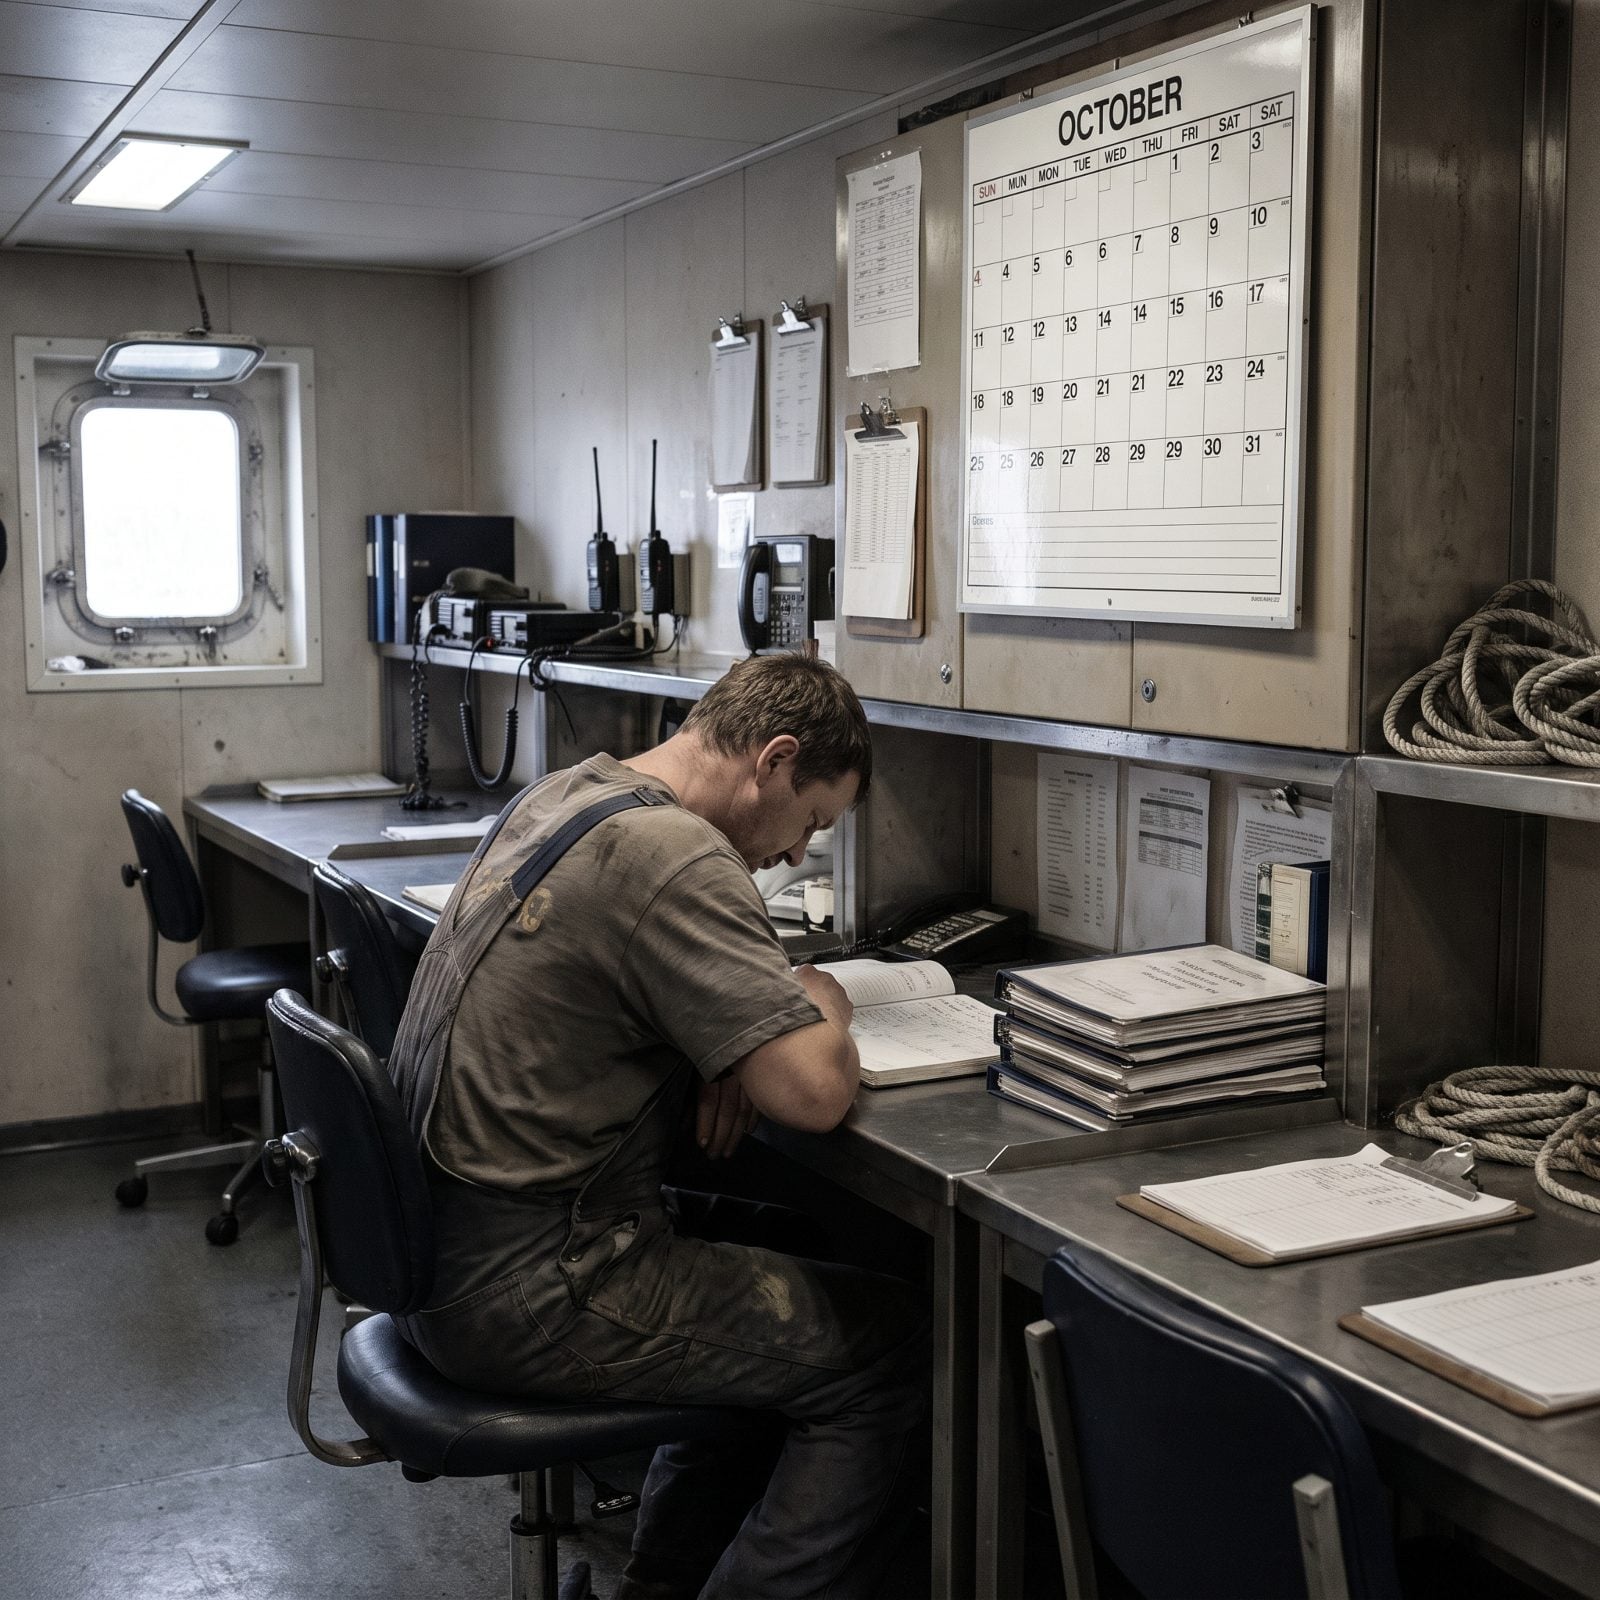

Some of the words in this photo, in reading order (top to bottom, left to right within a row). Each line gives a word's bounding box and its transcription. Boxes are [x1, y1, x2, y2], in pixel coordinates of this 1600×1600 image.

[1058, 76, 1183, 146] OCTOBER
[979, 184, 996, 199] SUN
[1008, 174, 1027, 190] MUN
[1038, 165, 1060, 182] MON
[1073, 156, 1092, 172] TUE
[1104, 146, 1127, 163] WED
[1142, 136, 1163, 153] THU
[1181, 126, 1199, 142] FRI
[1218, 113, 1241, 132] SAT
[1260, 101, 1283, 120] SAT
[1172, 153, 1178, 170] 1
[1210, 143, 1220, 162] 2
[1251, 131, 1261, 150] 3
[973, 270, 981, 284] 4
[1002, 264, 1010, 279] 4
[1033, 257, 1040, 273] 5
[1065, 250, 1073, 266] 6
[1099, 242, 1107, 259] 6
[1134, 234, 1142, 252] 7
[1171, 226, 1180, 243] 8
[1209, 217, 1218, 236] 9
[1250, 206, 1268, 226] 10
[974, 332, 984, 347] 11
[1002, 326, 1015, 343] 12
[1033, 321, 1045, 338] 12
[1065, 316, 1078, 333] 13
[1099, 310, 1112, 327] 14
[1133, 304, 1148, 321] 14
[1170, 297, 1184, 315] 15
[1209, 289, 1223, 308] 16
[1249, 283, 1265, 302] 17
[973, 394, 985, 409] 18
[1002, 390, 1014, 406] 18
[1032, 386, 1044, 402] 19
[1063, 383, 1078, 400] 20
[1097, 378, 1110, 395] 21
[1132, 374, 1146, 391] 21
[1168, 369, 1184, 387] 22
[1206, 364, 1223, 382] 23
[1247, 359, 1265, 378] 24
[970, 456, 984, 471] 25
[1000, 454, 1014, 469] 25
[1030, 451, 1044, 467] 26
[1062, 449, 1076, 465] 27
[1095, 446, 1111, 463] 28
[1130, 444, 1146, 461] 29
[1166, 441, 1183, 458] 29
[1204, 438, 1222, 456] 30
[1245, 435, 1261, 453] 31
